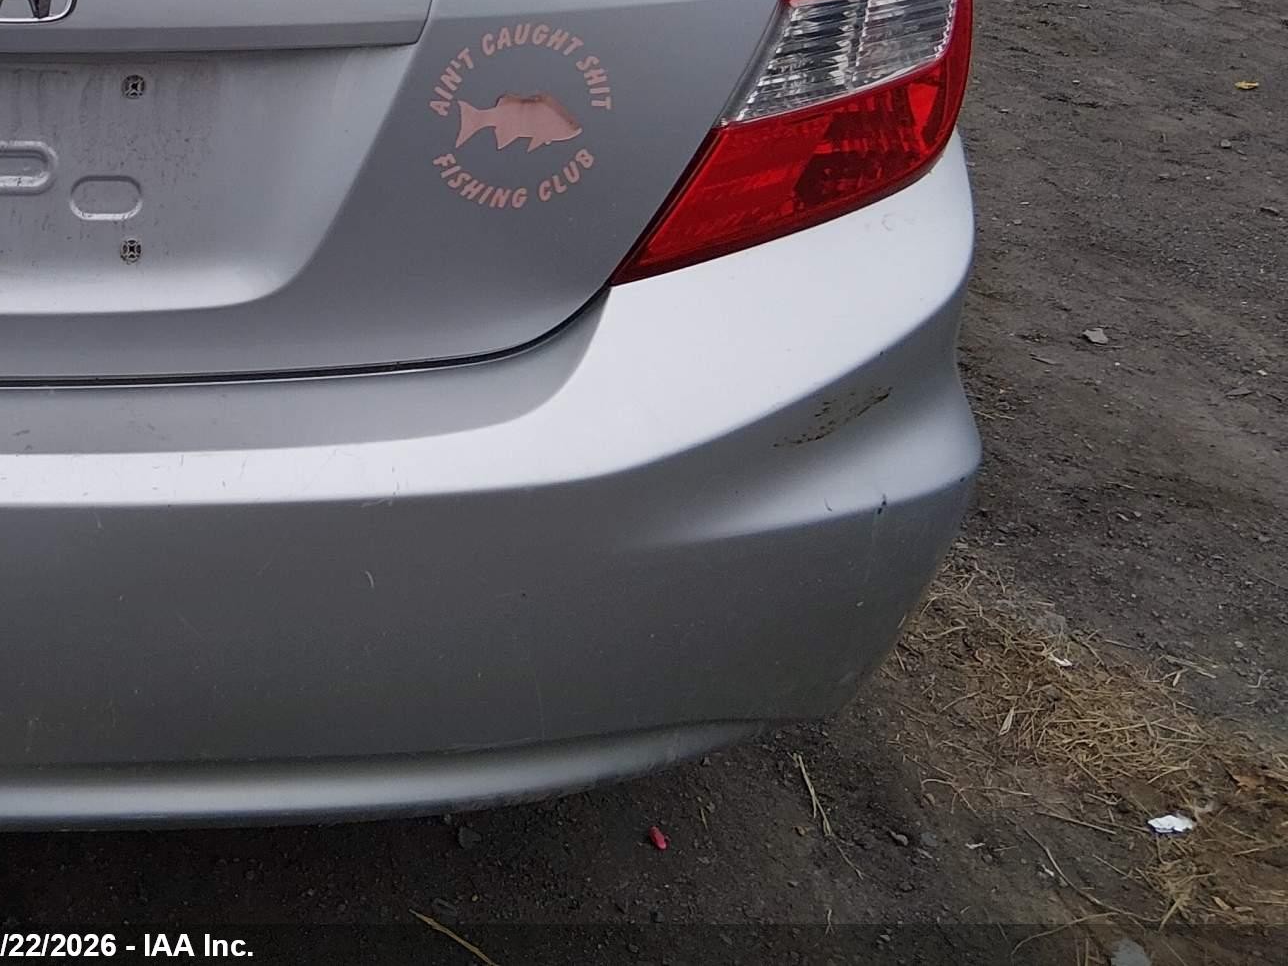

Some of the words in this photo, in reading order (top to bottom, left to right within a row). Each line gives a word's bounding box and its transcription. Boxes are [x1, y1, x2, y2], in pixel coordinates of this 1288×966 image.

[429, 47, 474, 117] AIN'T
[481, 23, 584, 56] CAUGHT
[576, 55, 611, 110] SHIT
[432, 153, 528, 208] FISHING
[539, 148, 594, 202] CLUB
